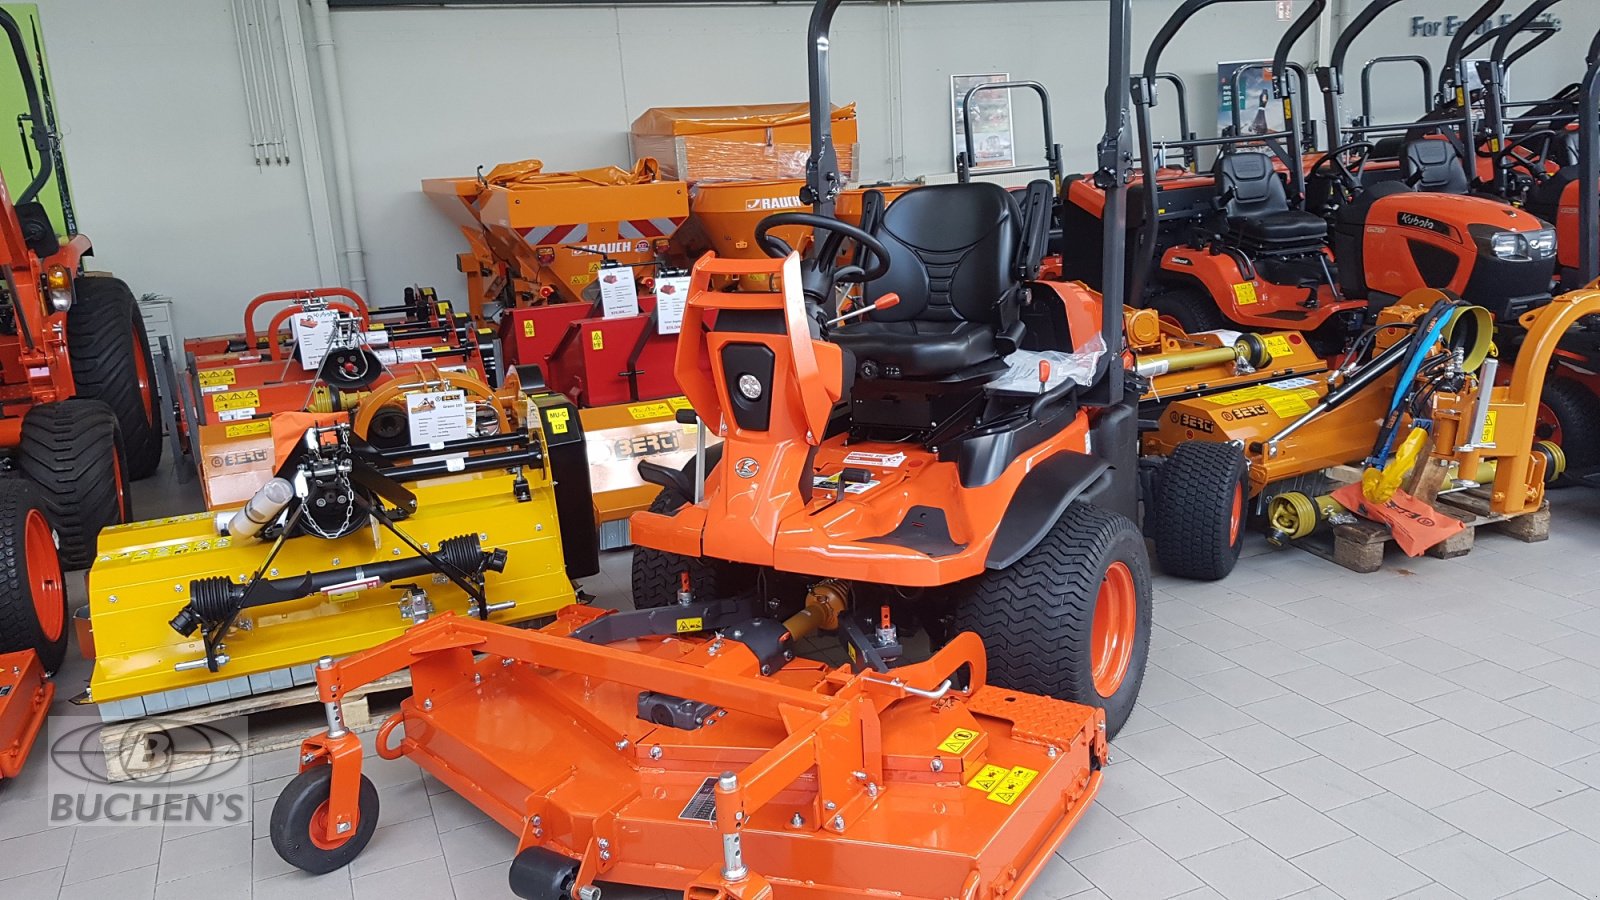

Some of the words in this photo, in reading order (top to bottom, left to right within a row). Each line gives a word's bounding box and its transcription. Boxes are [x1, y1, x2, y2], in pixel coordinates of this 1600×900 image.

[1411, 16, 1441, 37] For
[762, 196, 801, 209] RAUCH
[1401, 213, 1434, 229] Kubota
[588, 241, 631, 255] RAUCH
